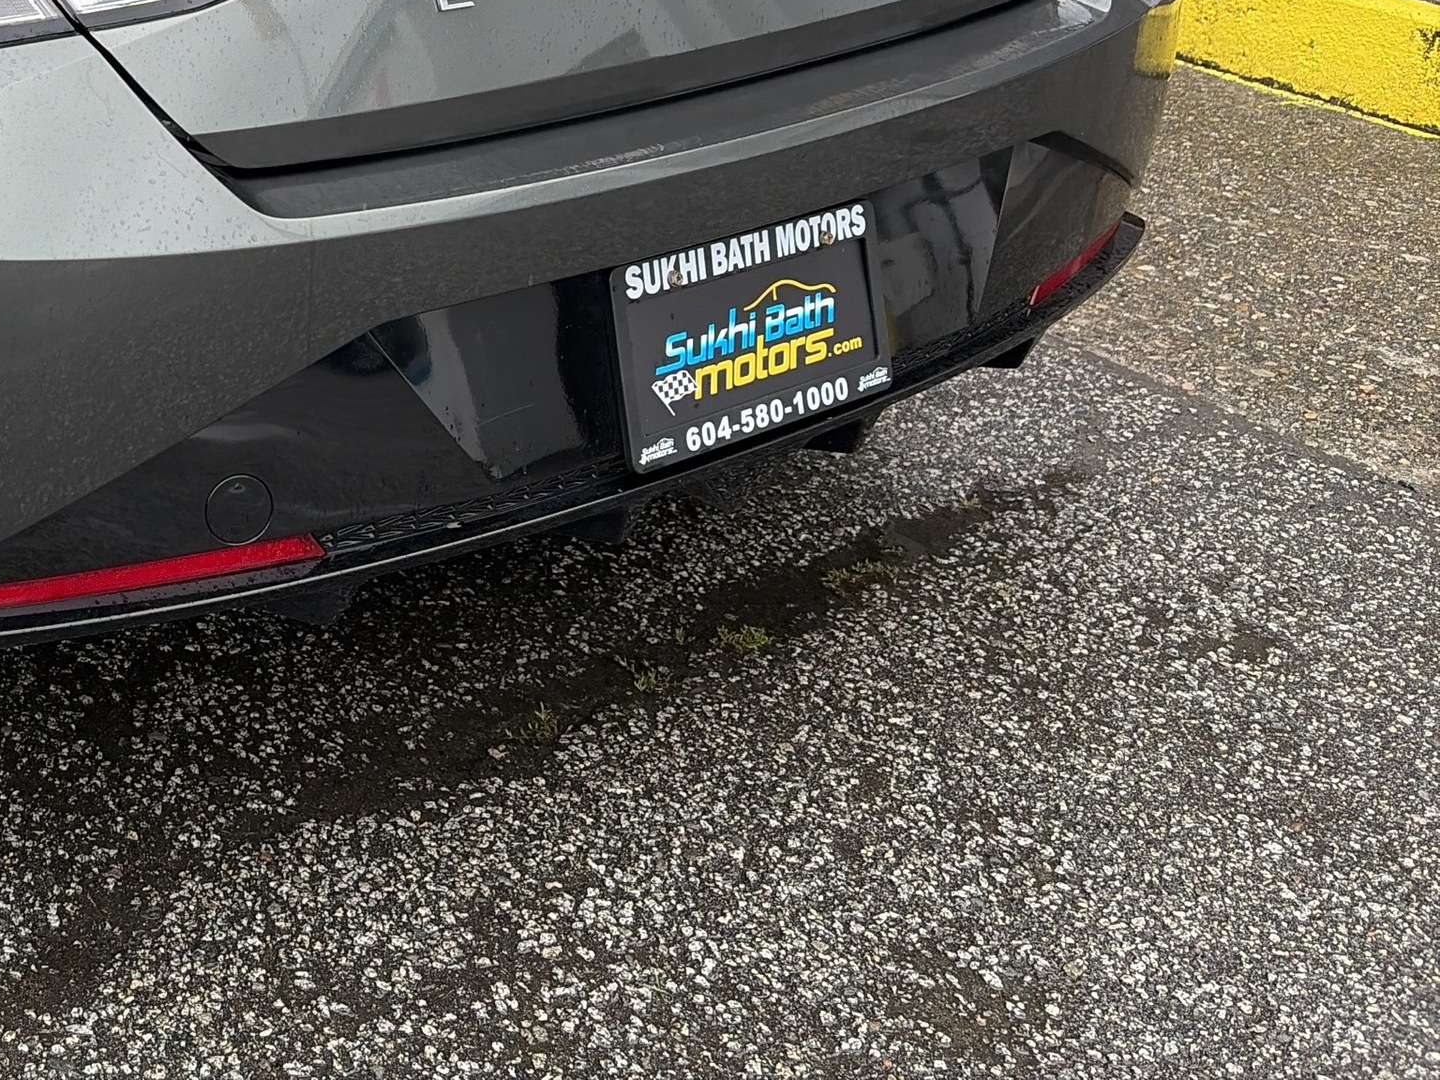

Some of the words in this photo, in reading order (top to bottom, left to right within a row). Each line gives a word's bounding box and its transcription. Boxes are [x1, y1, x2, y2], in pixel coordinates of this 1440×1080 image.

[624, 246, 708, 300] SUKHI
[710, 229, 771, 278] BATH
[774, 204, 867, 258] MOTORS
[655, 308, 757, 376] Sukhi
[764, 292, 835, 344] Bath
[685, 376, 849, 452] 604-580-1000
